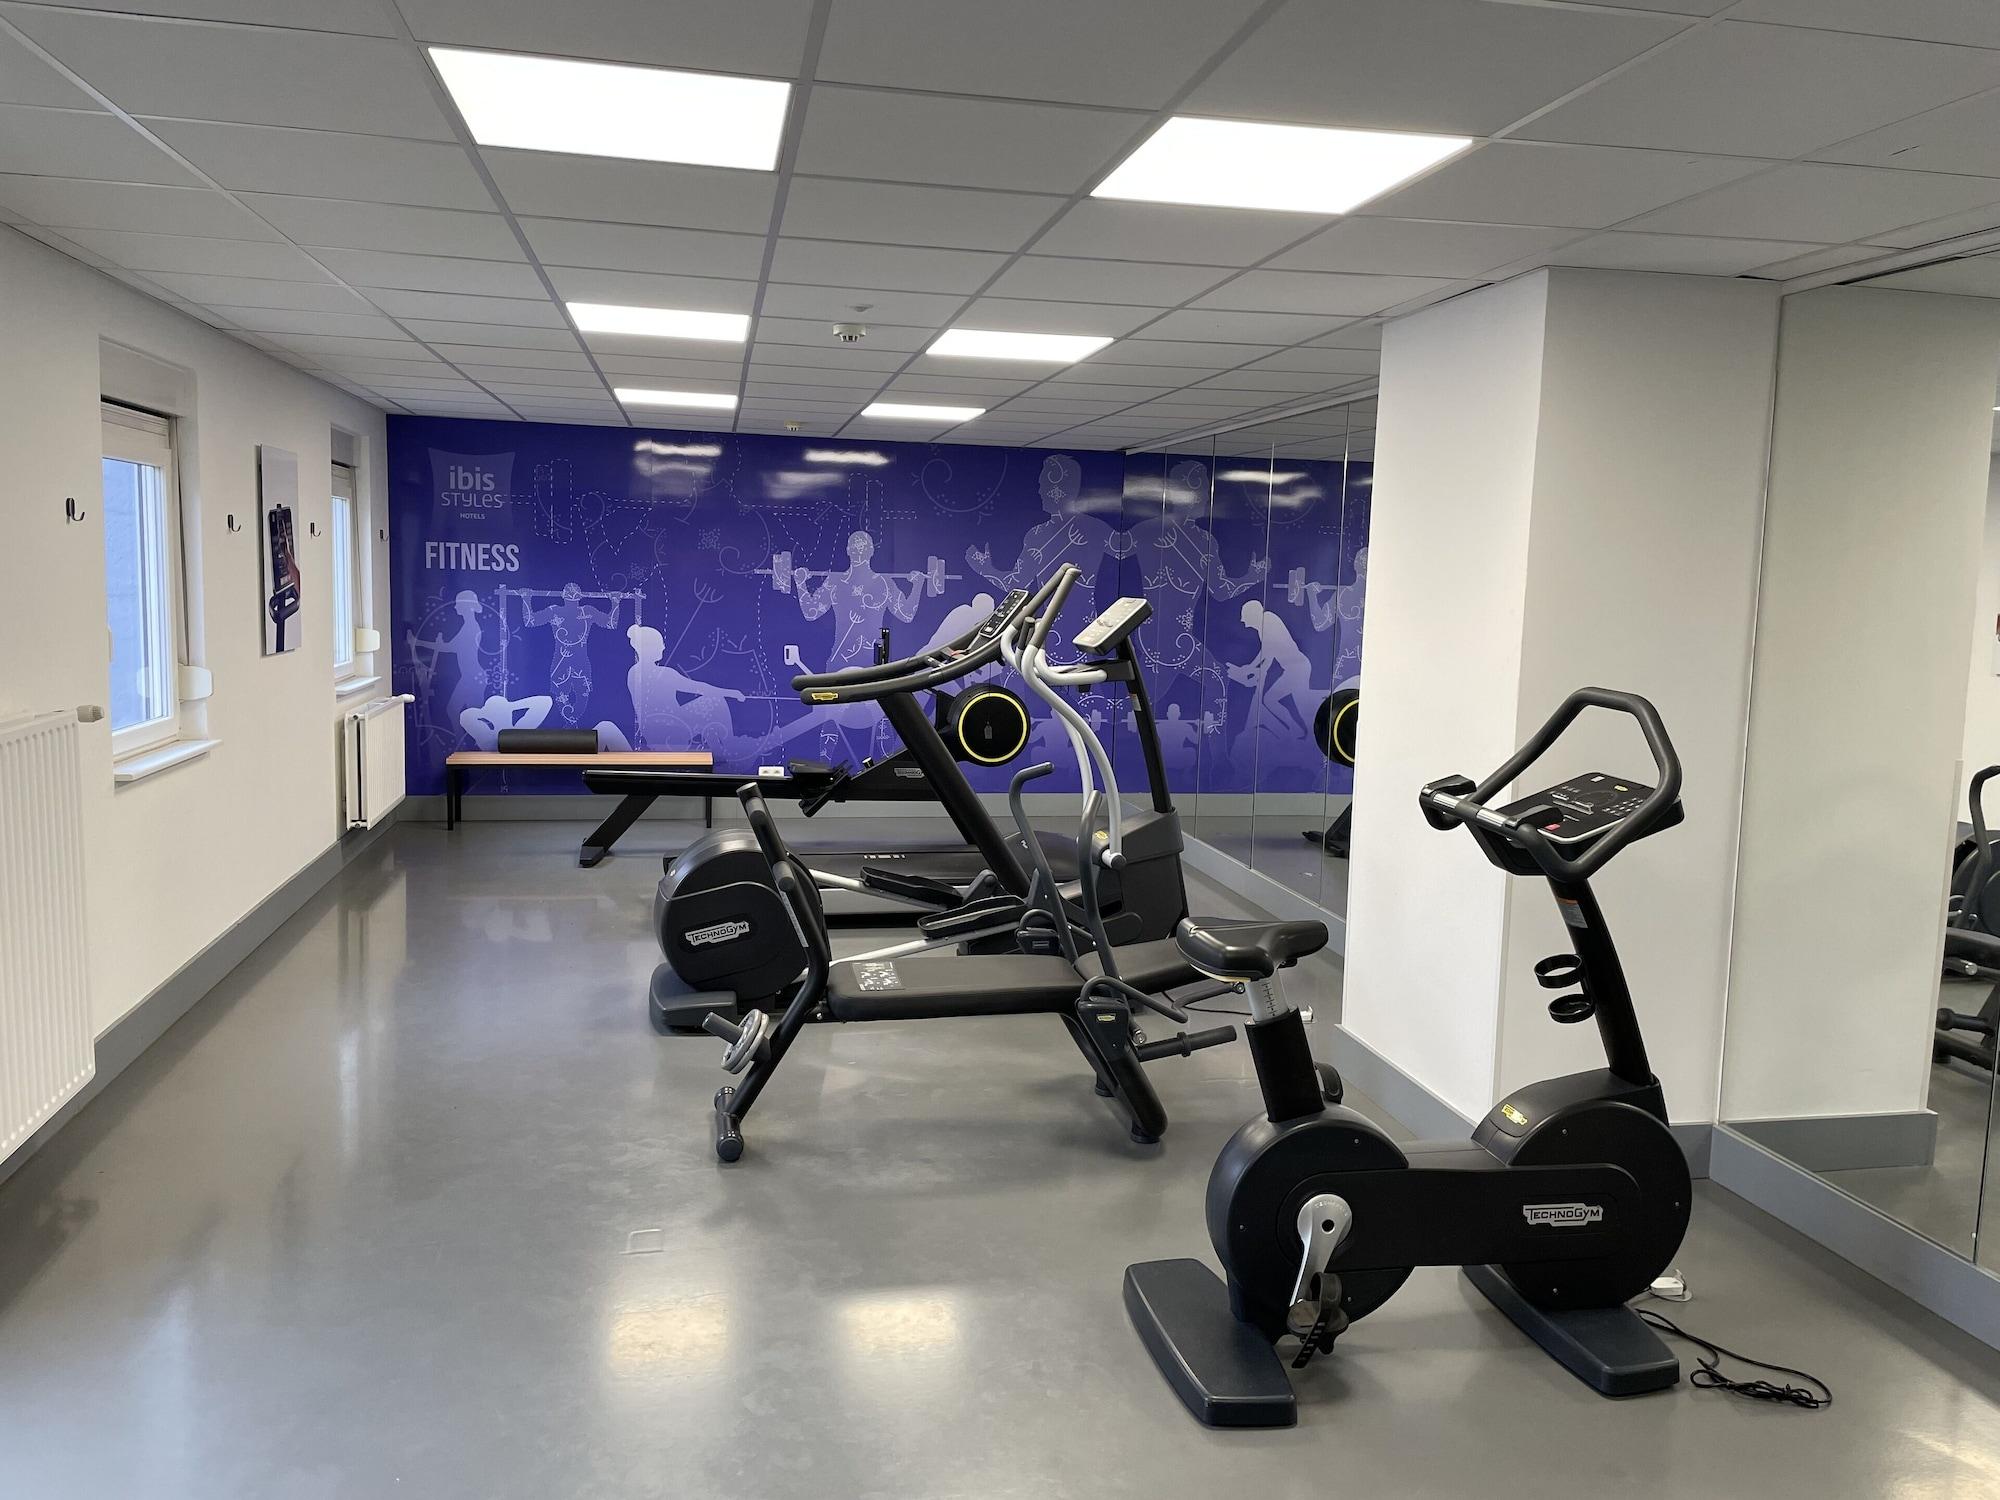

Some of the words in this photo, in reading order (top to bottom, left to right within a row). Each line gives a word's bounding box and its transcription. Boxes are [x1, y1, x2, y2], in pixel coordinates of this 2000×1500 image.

[450, 466, 495, 491] ibis
[460, 512, 486, 520] HOTELS
[425, 541, 520, 572] FITNESS
